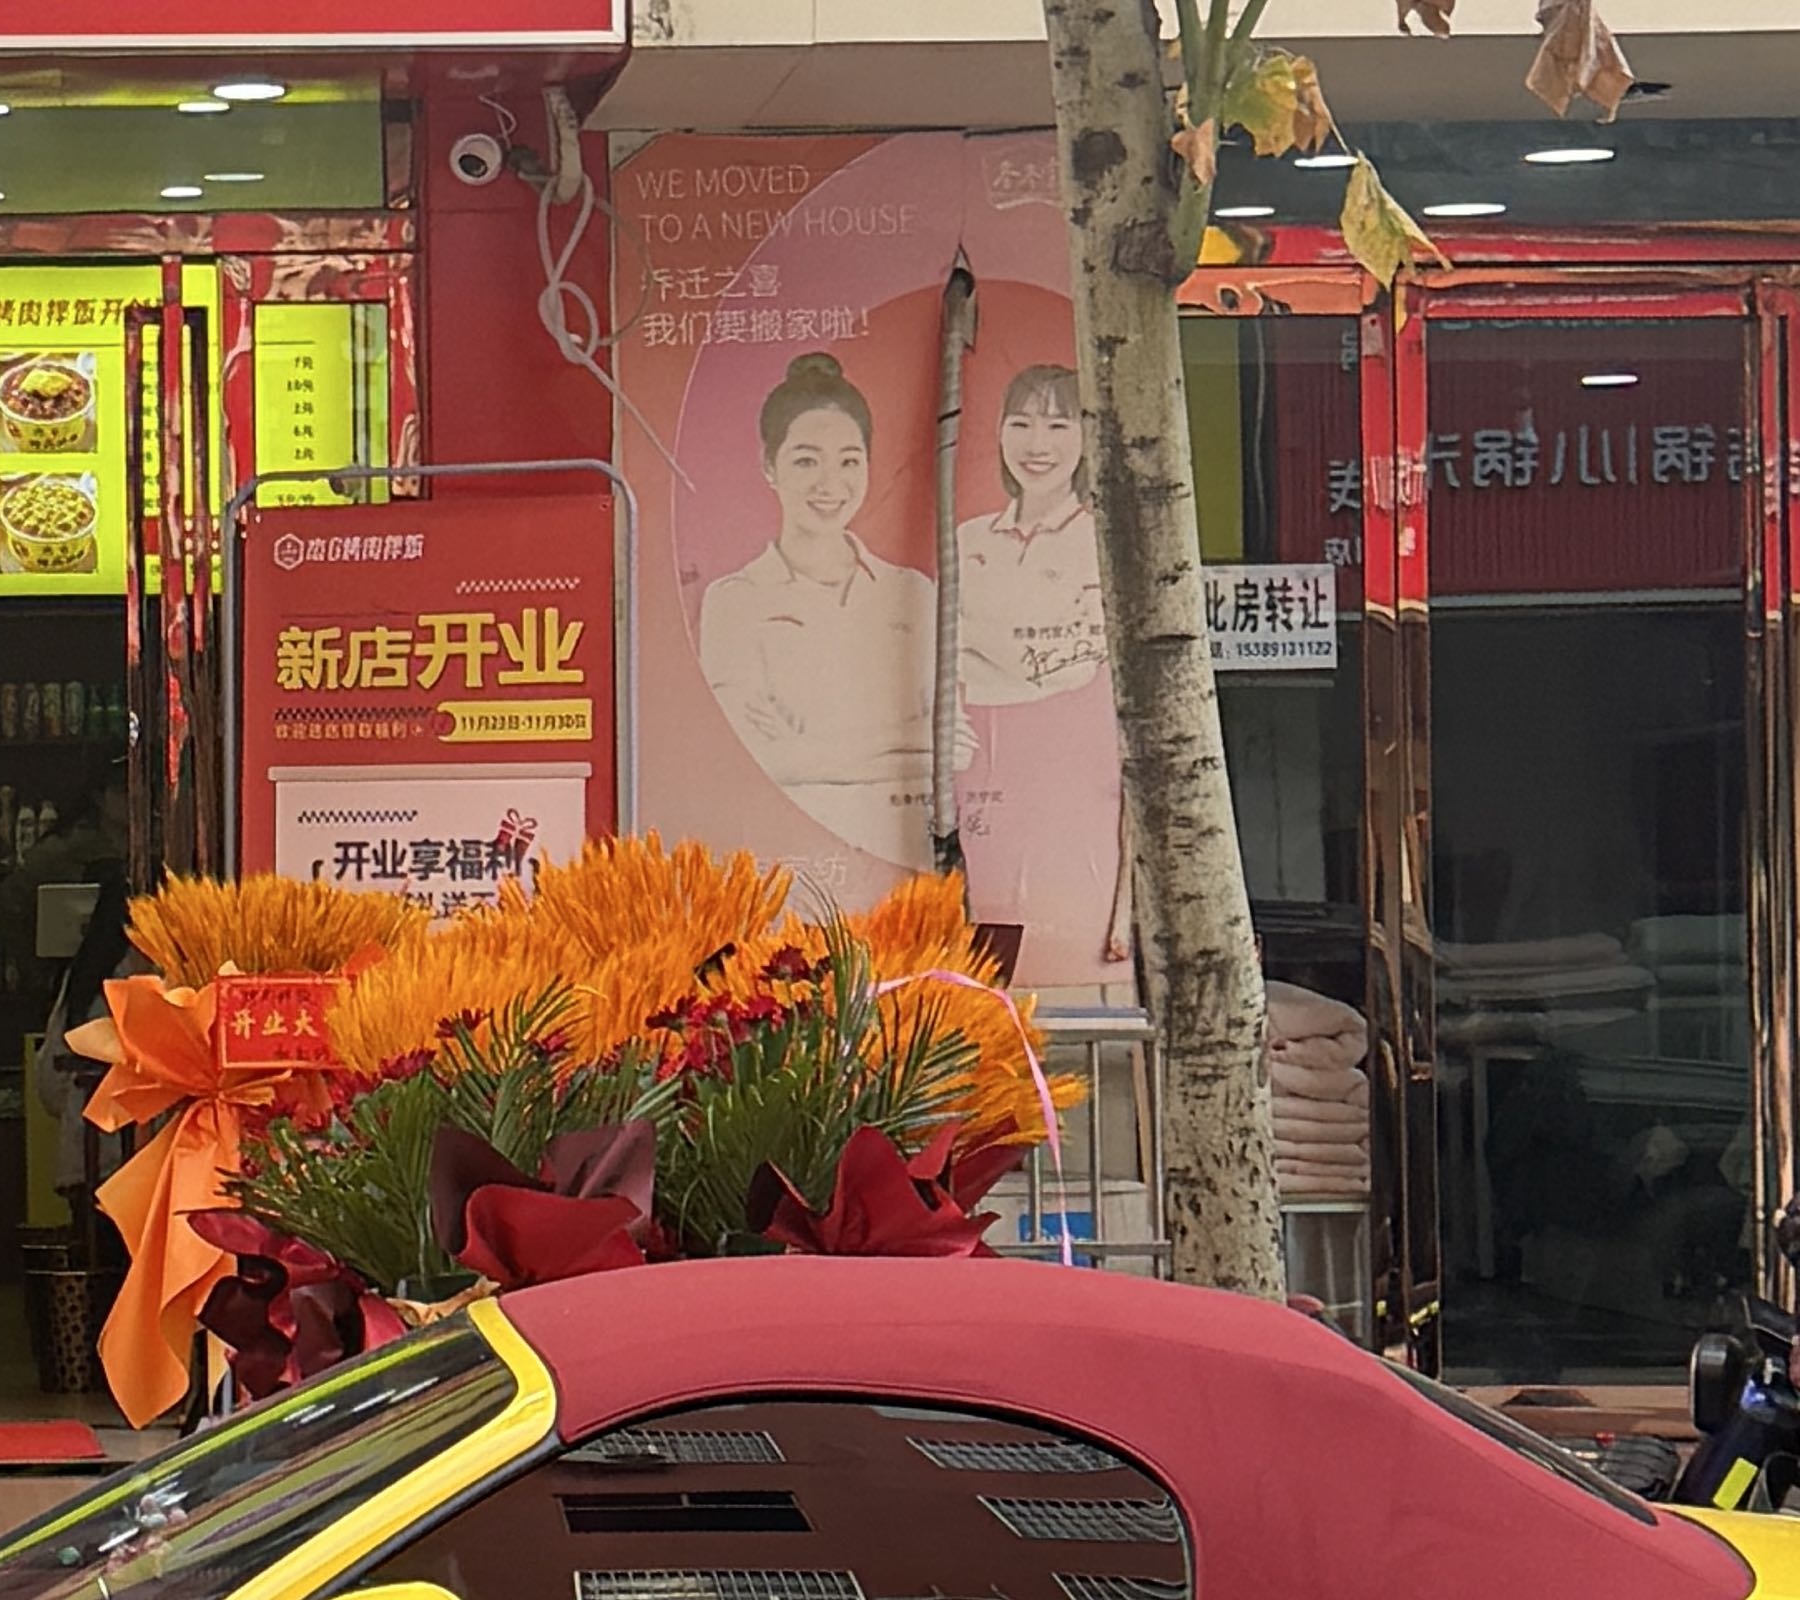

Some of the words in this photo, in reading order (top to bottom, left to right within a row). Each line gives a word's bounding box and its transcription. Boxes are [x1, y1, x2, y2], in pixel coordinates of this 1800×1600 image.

[636, 168, 684, 199] WE
[694, 165, 810, 197] MOVED
[642, 215, 682, 244] TO
[688, 213, 714, 242] A
[721, 210, 793, 240] NEW
[806, 205, 914, 238] HOUSE
[1204, 577, 1329, 633] 此房转让
[276, 607, 585, 691] 新店开业
[333, 838, 523, 882] 开业享福利
[230, 1008, 319, 1040] 开业大
